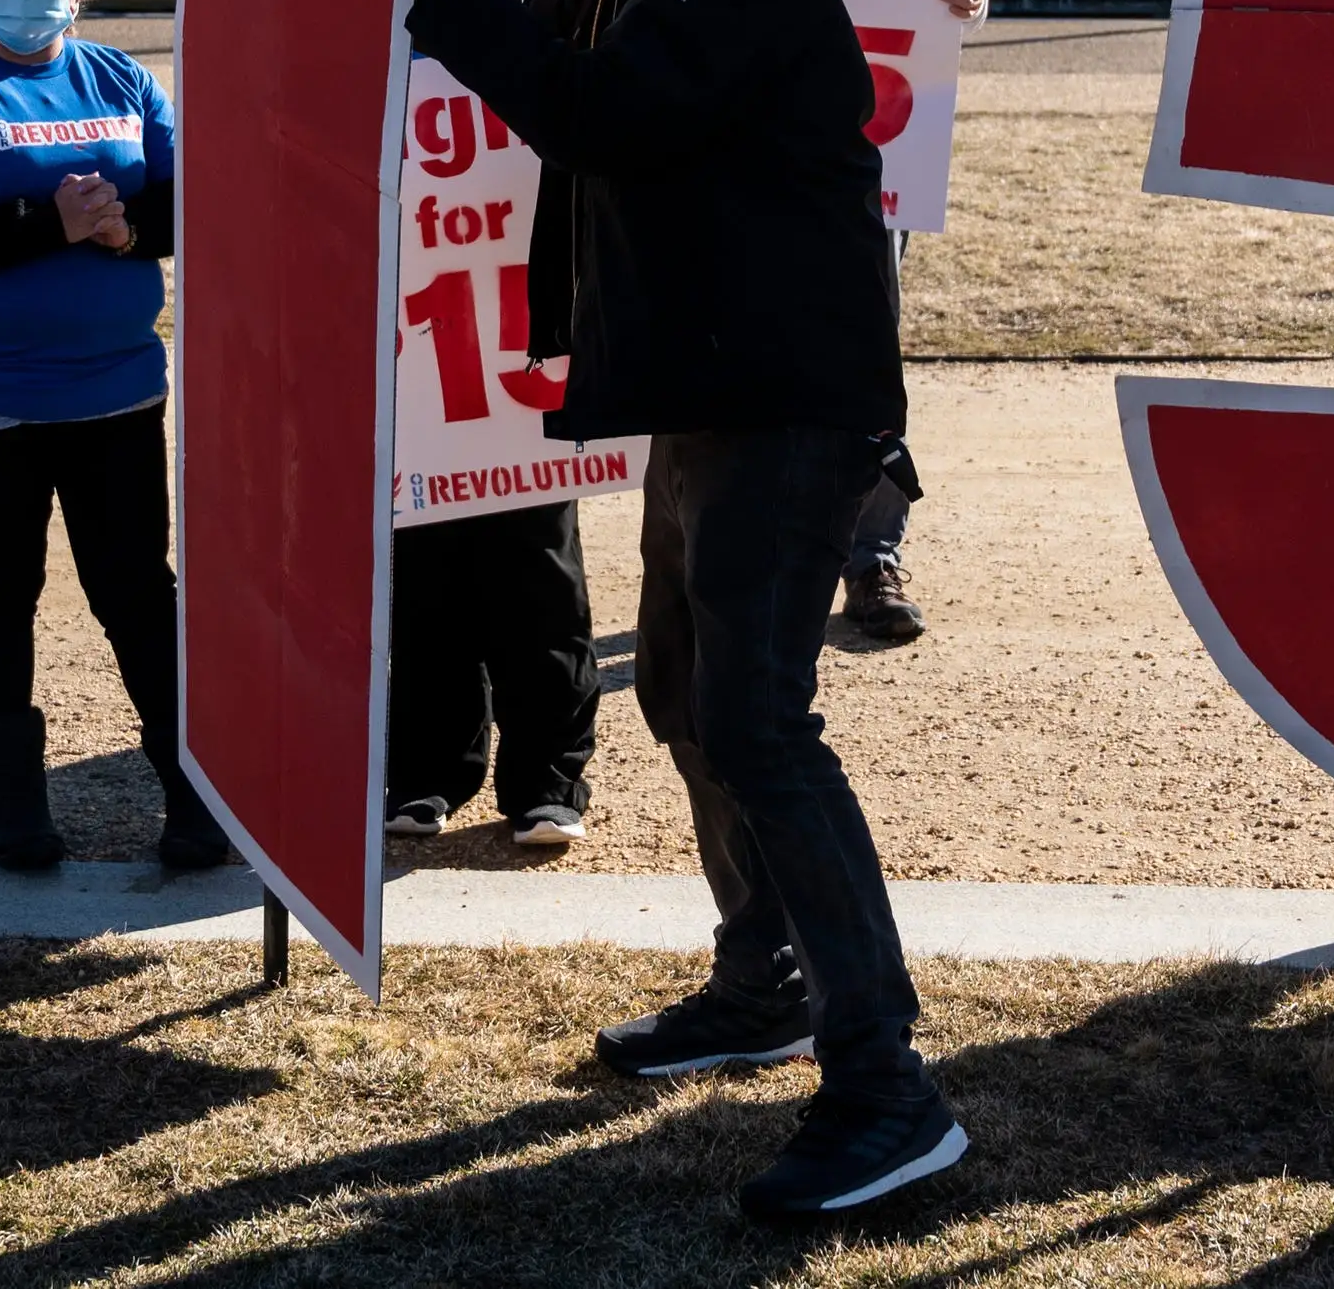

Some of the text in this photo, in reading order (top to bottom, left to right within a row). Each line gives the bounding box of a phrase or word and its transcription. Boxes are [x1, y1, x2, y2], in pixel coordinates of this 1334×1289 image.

[414, 195, 514, 249] for
[410, 451, 628, 510] OUR REVOLUTION
